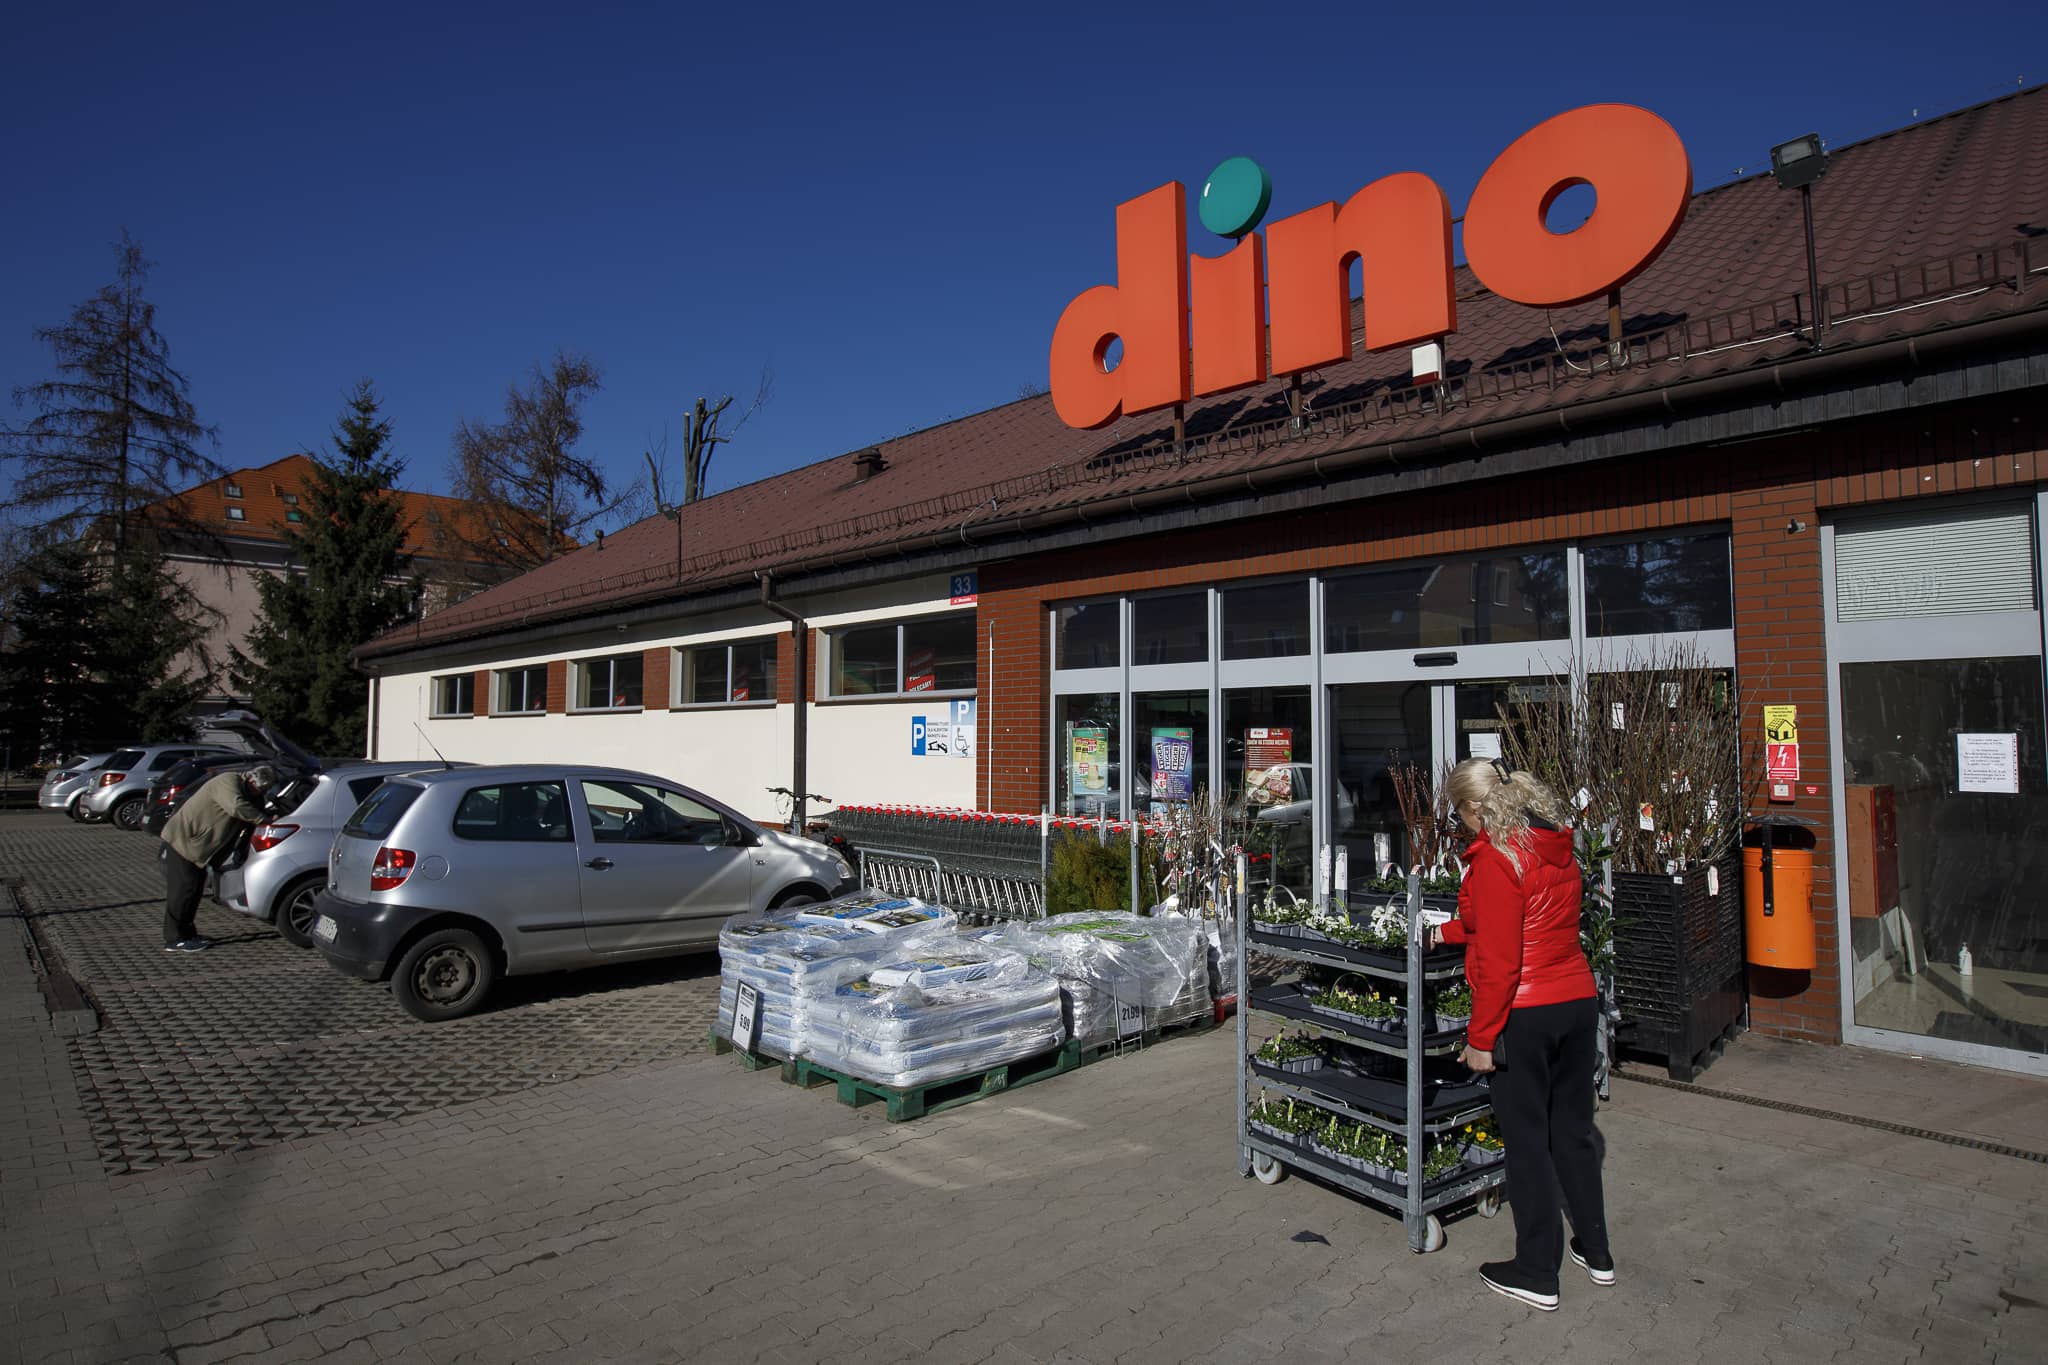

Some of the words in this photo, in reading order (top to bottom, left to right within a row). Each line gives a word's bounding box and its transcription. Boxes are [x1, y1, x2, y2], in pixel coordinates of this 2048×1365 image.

[1050, 102, 1692, 430] dino
[954, 575, 971, 594] 33
[909, 679, 932, 692] LECAMY
[957, 700, 970, 722] P
[913, 723, 925, 748] P
